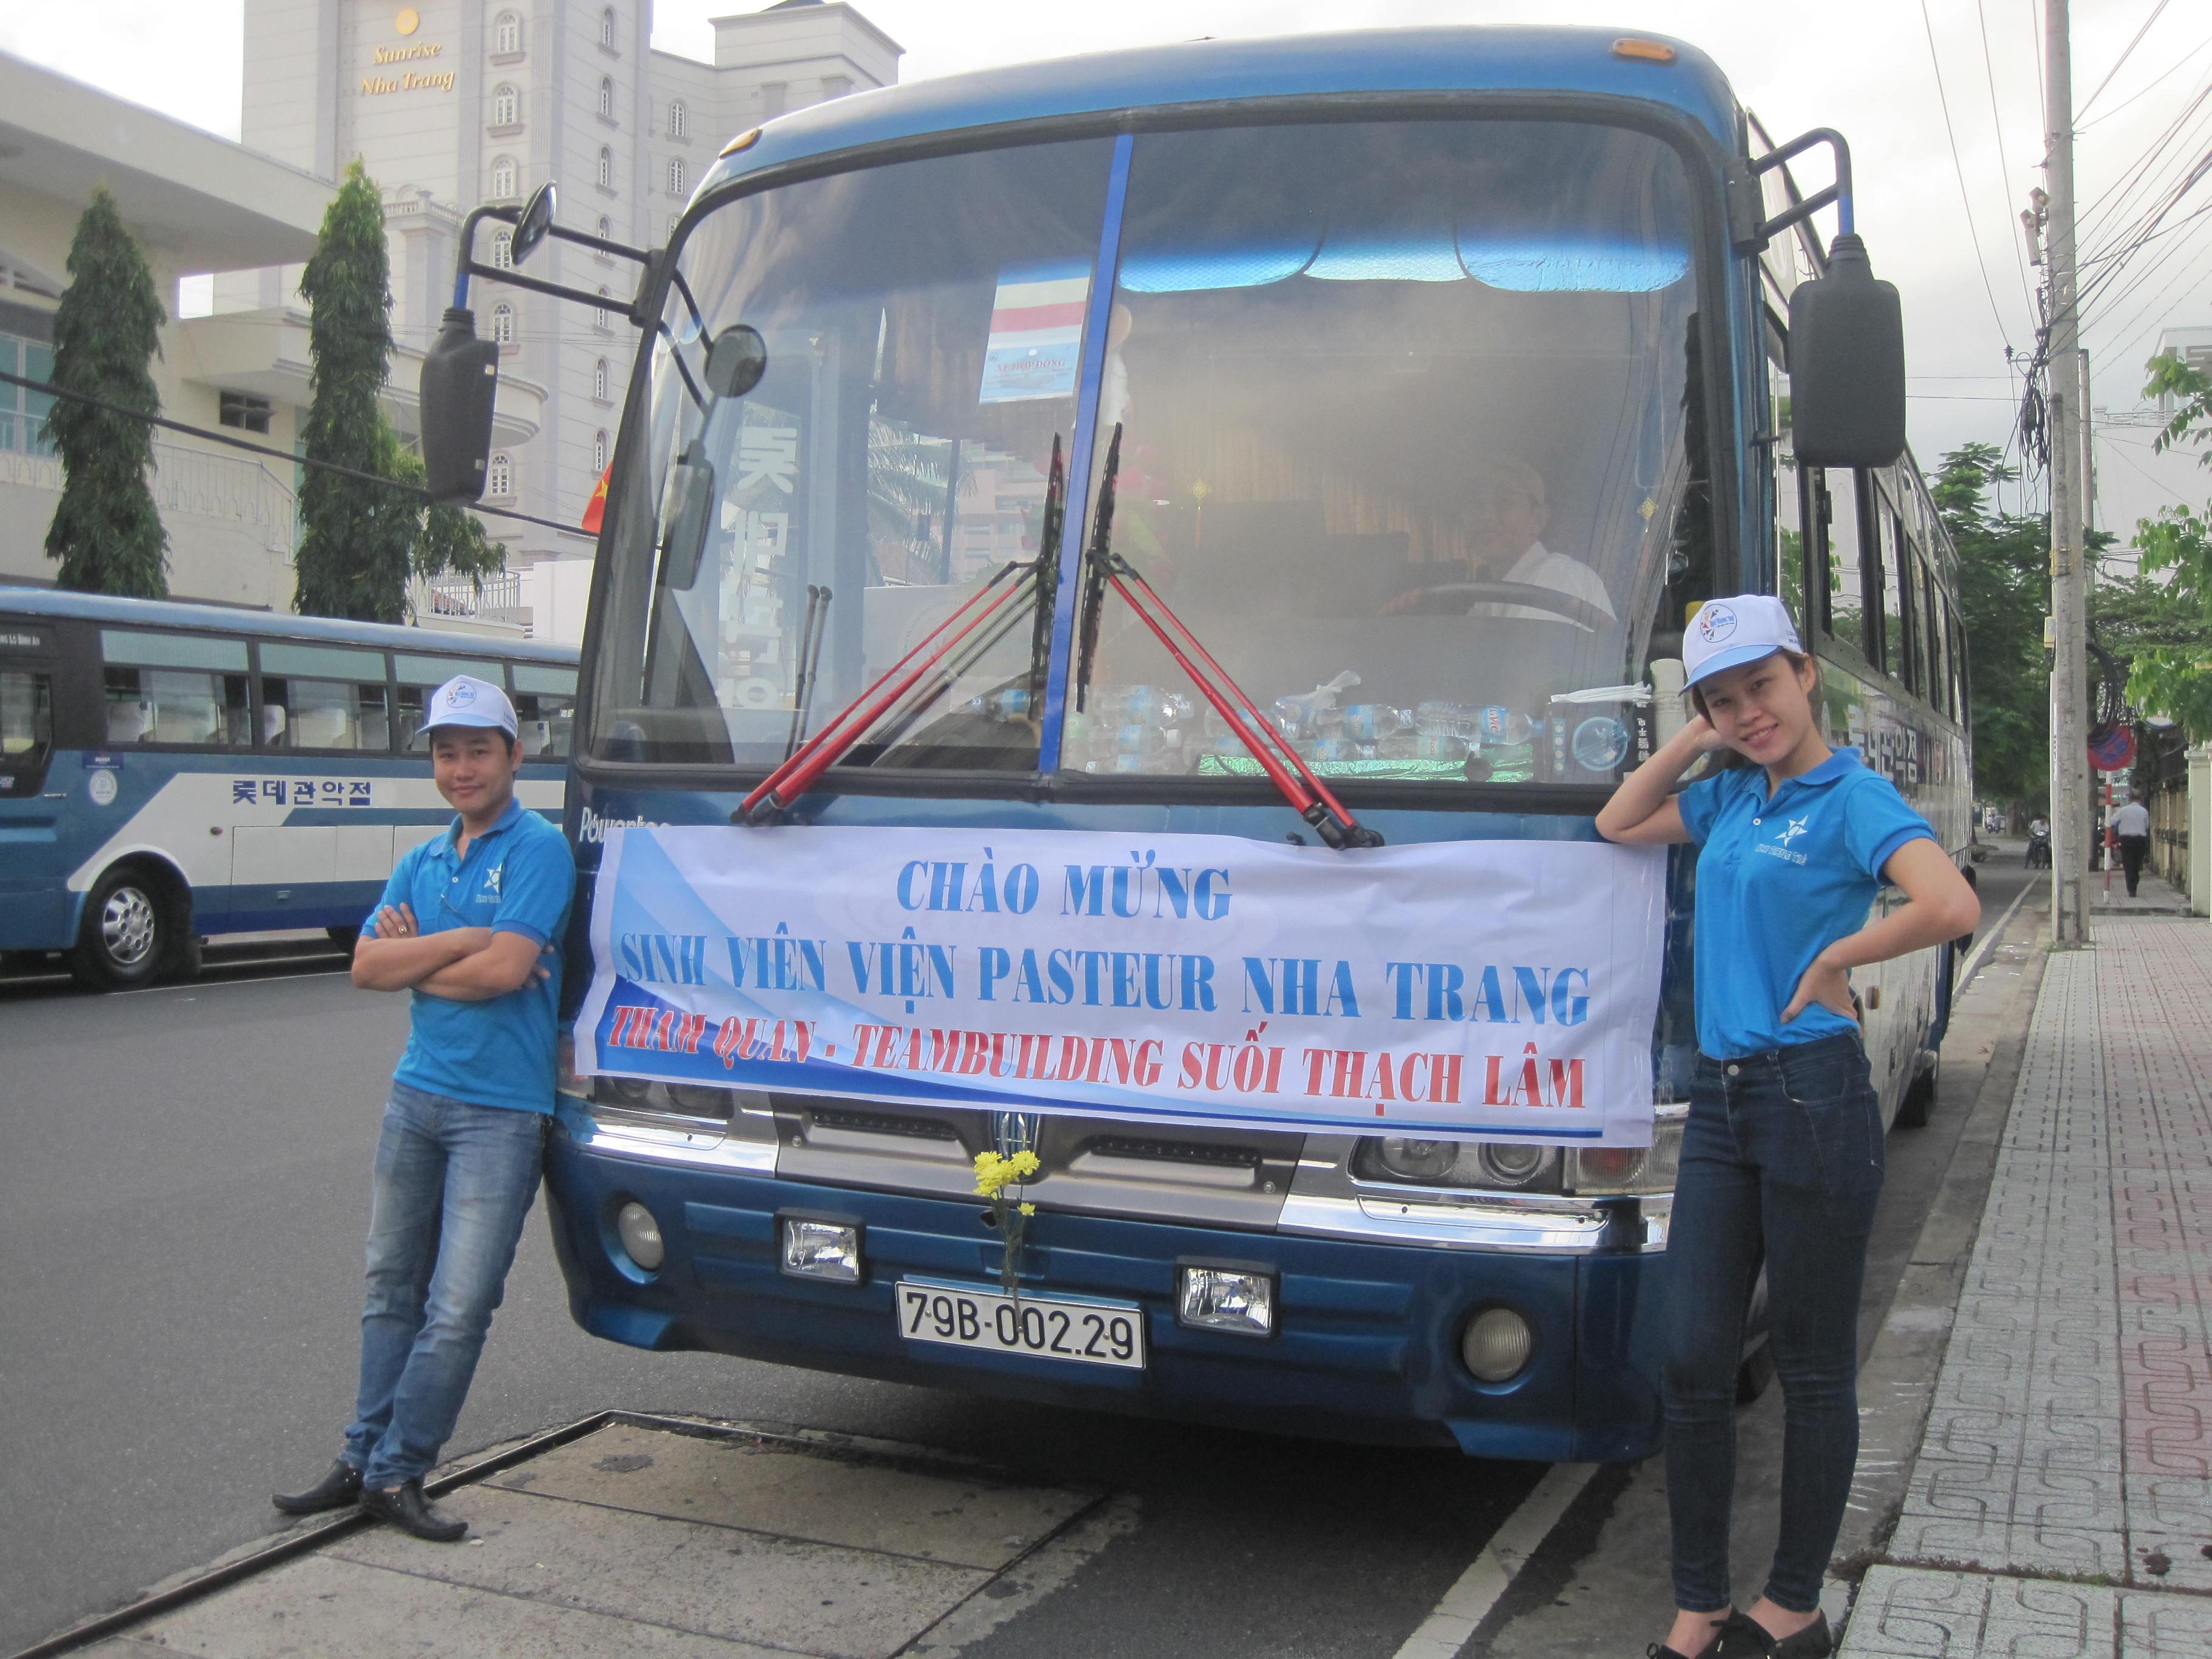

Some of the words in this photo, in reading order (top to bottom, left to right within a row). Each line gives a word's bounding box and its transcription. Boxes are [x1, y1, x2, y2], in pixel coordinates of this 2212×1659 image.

[361, 77, 398, 96] Nha
[403, 72, 455, 91] Trang
[374, 42, 442, 65] Sunrise
[233, 780, 372, 806] 롯데관악점
[897, 847, 1039, 914] CHÀO
[1061, 850, 1232, 920] MỪNG
[620, 932, 708, 985] SINH
[726, 922, 826, 992] VIÊN
[846, 927, 957, 1014] VIỆN
[977, 947, 1217, 1012] PASTEUR
[1242, 957, 1362, 1017] NHA
[1386, 962, 1589, 1027] TRANG
[607, 1006, 707, 1053] THAM
[713, 1016, 817, 1070] QUAN
[852, 1025, 1164, 1086] TEAMBUILDING
[1178, 1021, 1285, 1093] SUỐI
[1303, 1048, 1465, 1116] THẠCH
[1482, 1042, 1586, 1108] LÂM
[907, 1292, 1133, 1359] 79B-002.29
